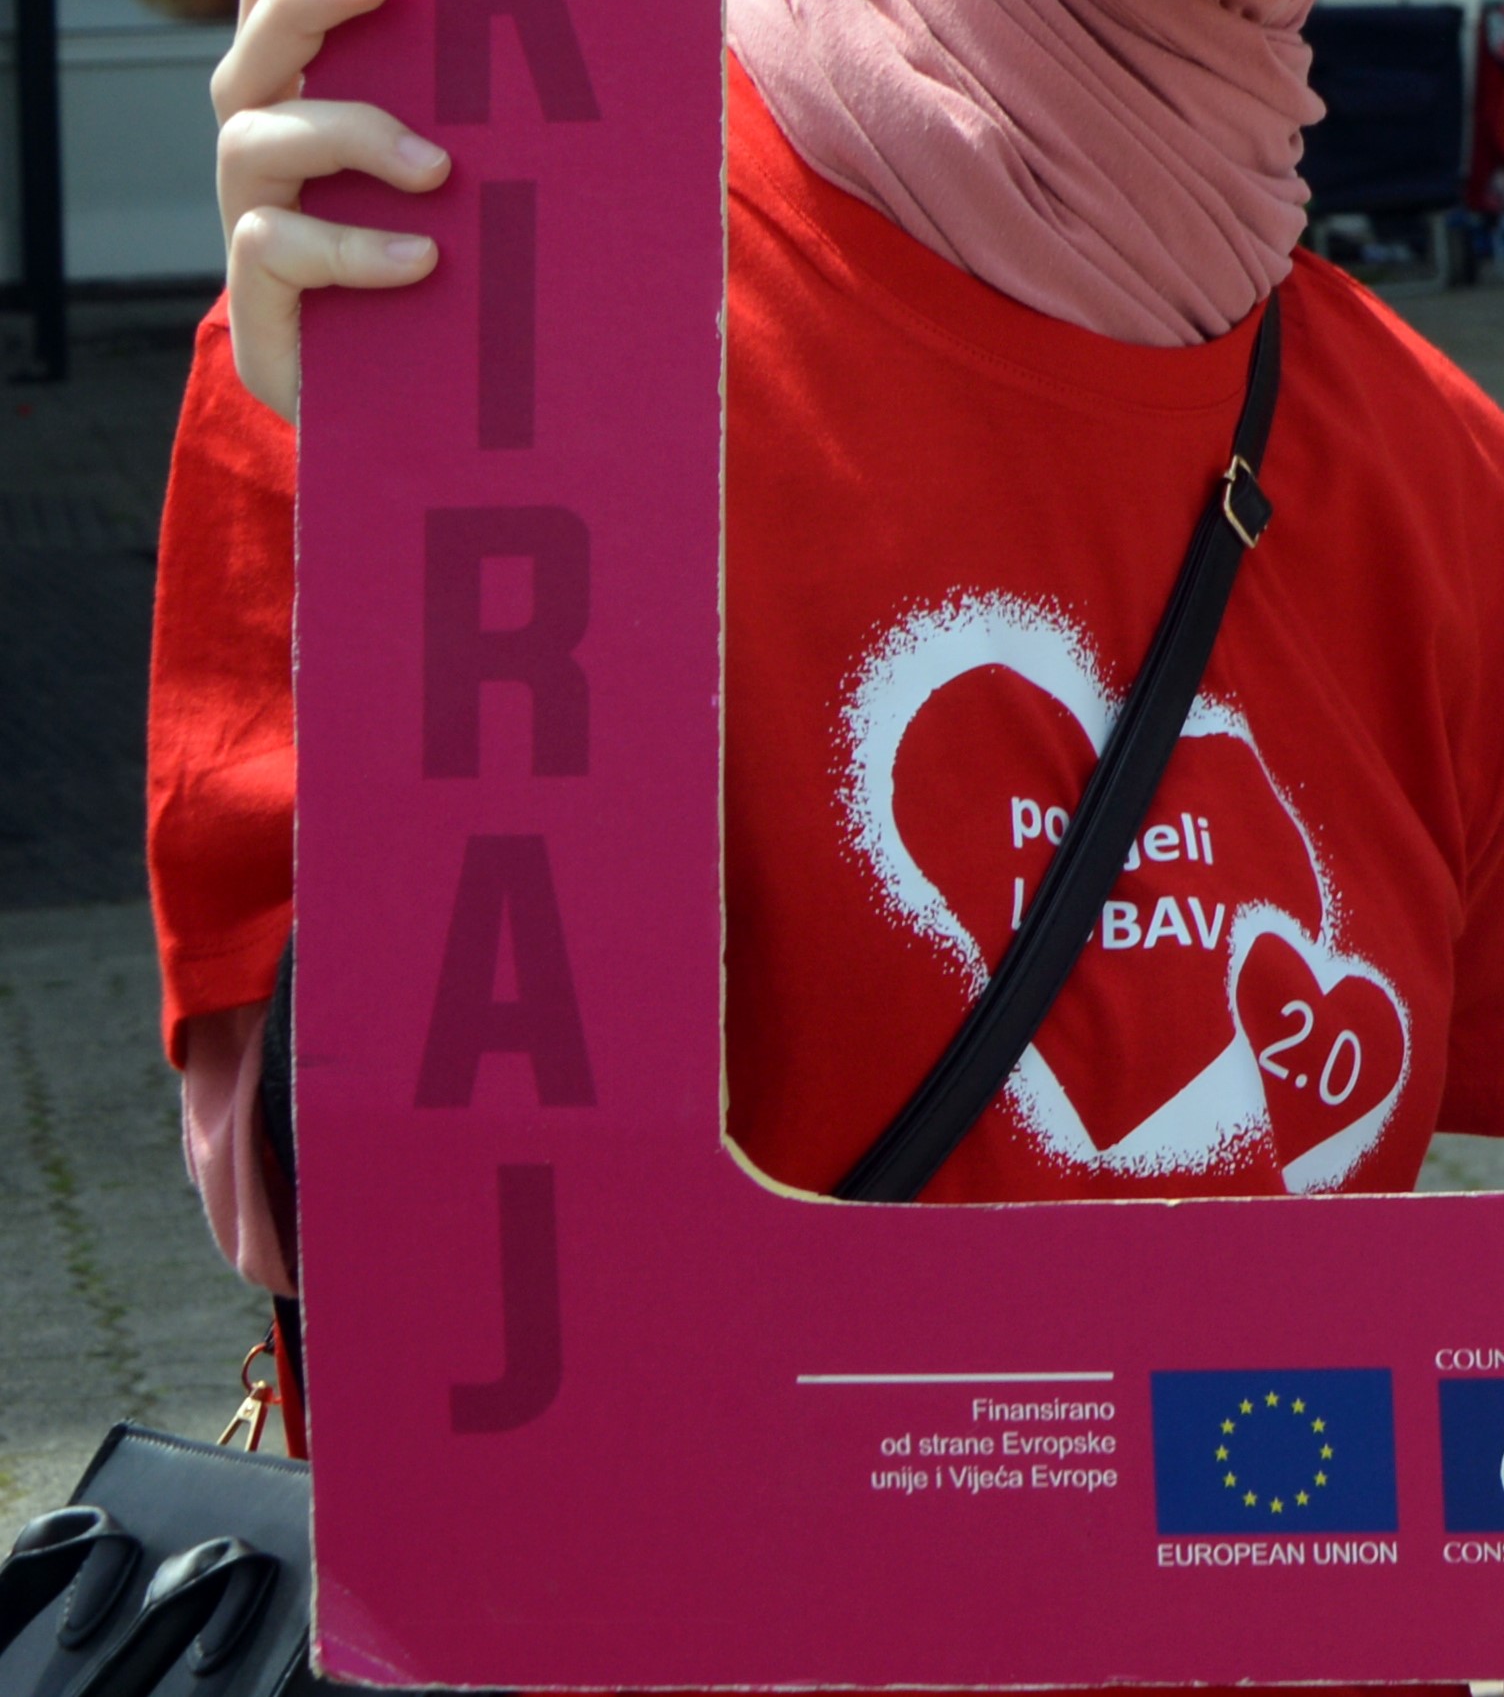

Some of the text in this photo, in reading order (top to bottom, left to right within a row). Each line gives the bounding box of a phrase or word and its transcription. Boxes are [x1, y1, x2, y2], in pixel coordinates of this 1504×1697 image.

[1011, 876, 1225, 950] LBAV
[1259, 1000, 1362, 1106] 2.0
[972, 1398, 1116, 1421] Finansirano
[881, 1431, 1117, 1459] od strane Evropske
[871, 1464, 1118, 1495] unije i Vijeća Evrope
[1157, 1541, 1398, 1567] EUROPEAN UNION
